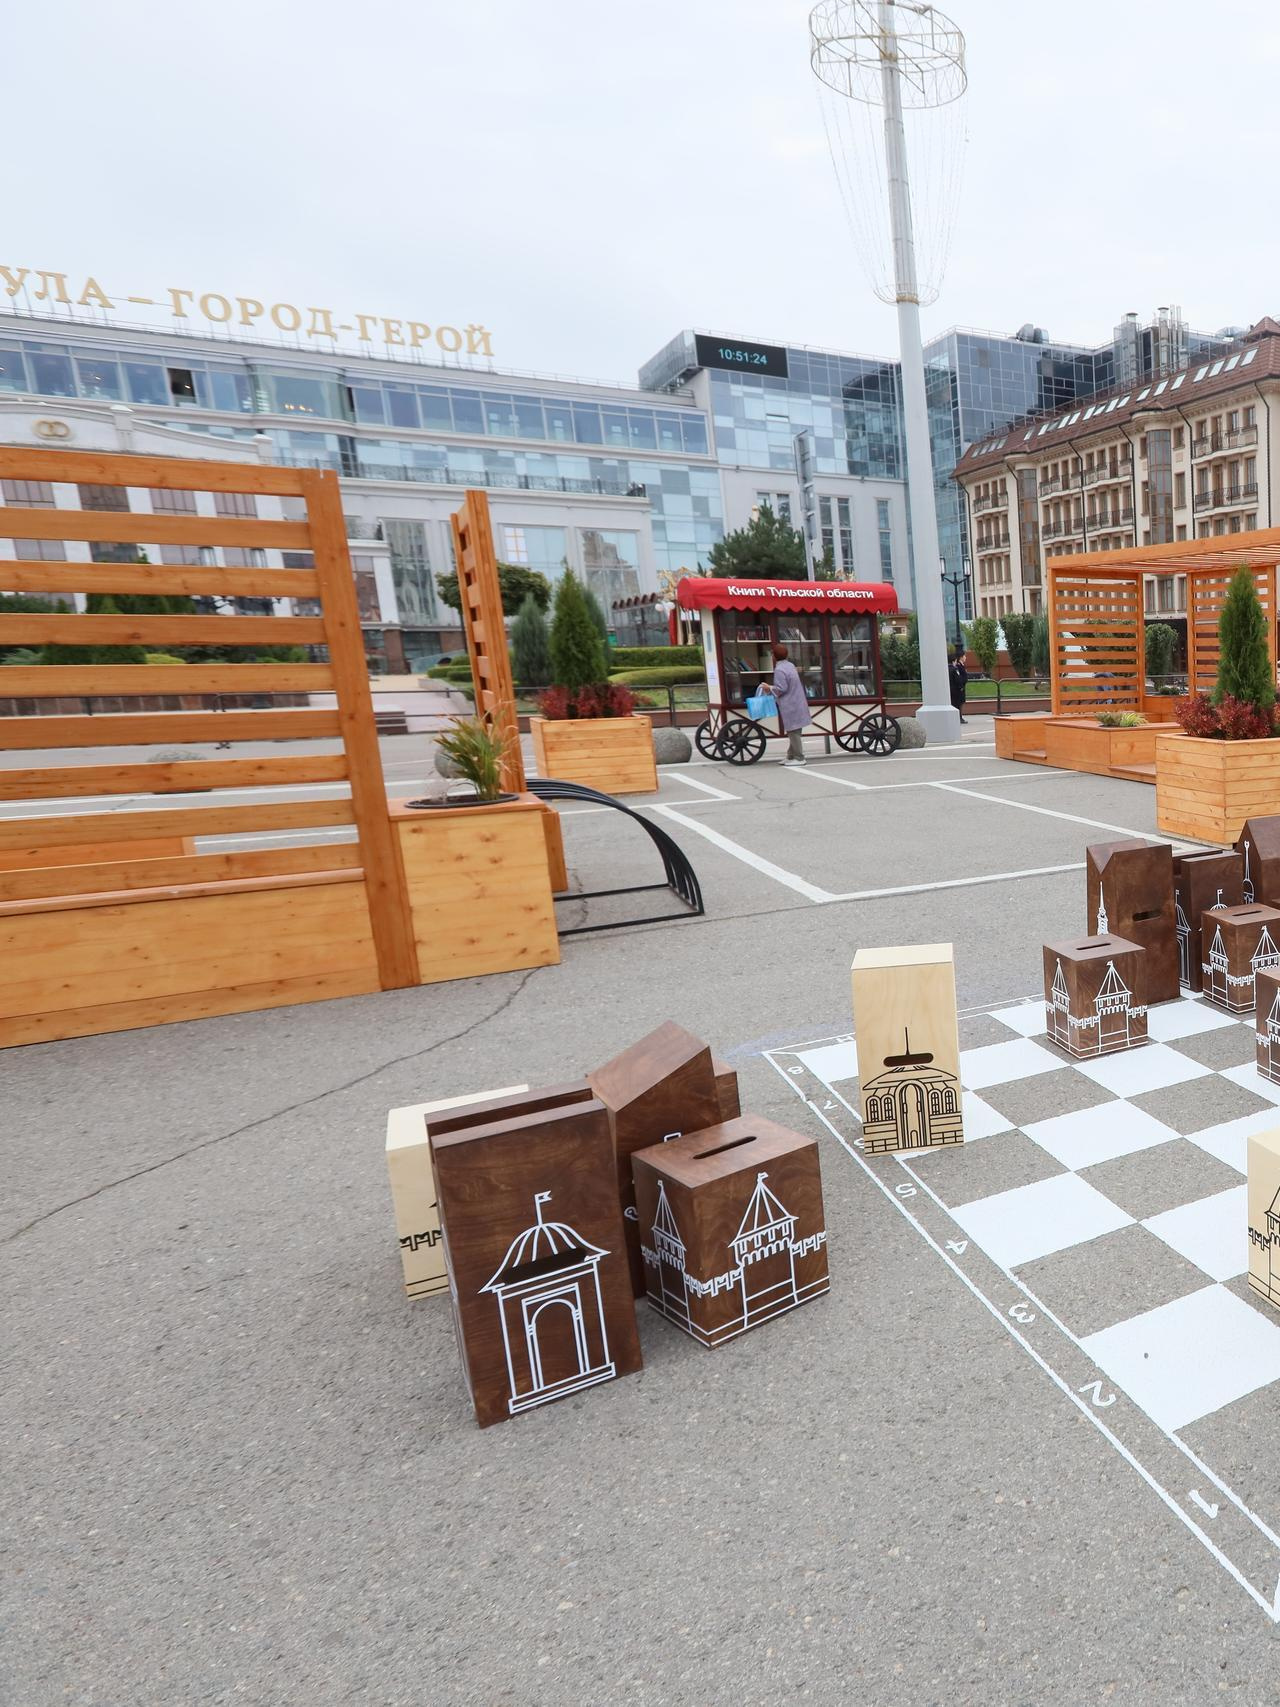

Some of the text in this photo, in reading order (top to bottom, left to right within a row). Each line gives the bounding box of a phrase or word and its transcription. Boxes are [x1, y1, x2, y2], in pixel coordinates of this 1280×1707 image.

[167, 288, 495, 357] ГОРОД-ГЕРОЙ
[718, 348, 768, 365] 10:51:24
[727, 585, 874, 599] Книги Тульской области
[895, 1182, 918, 1198] 5
[945, 1239, 970, 1255] 4
[1007, 1303, 1036, 1324] 3
[1078, 1380, 1117, 1408] 2
[1188, 1489, 1219, 1519] 1
